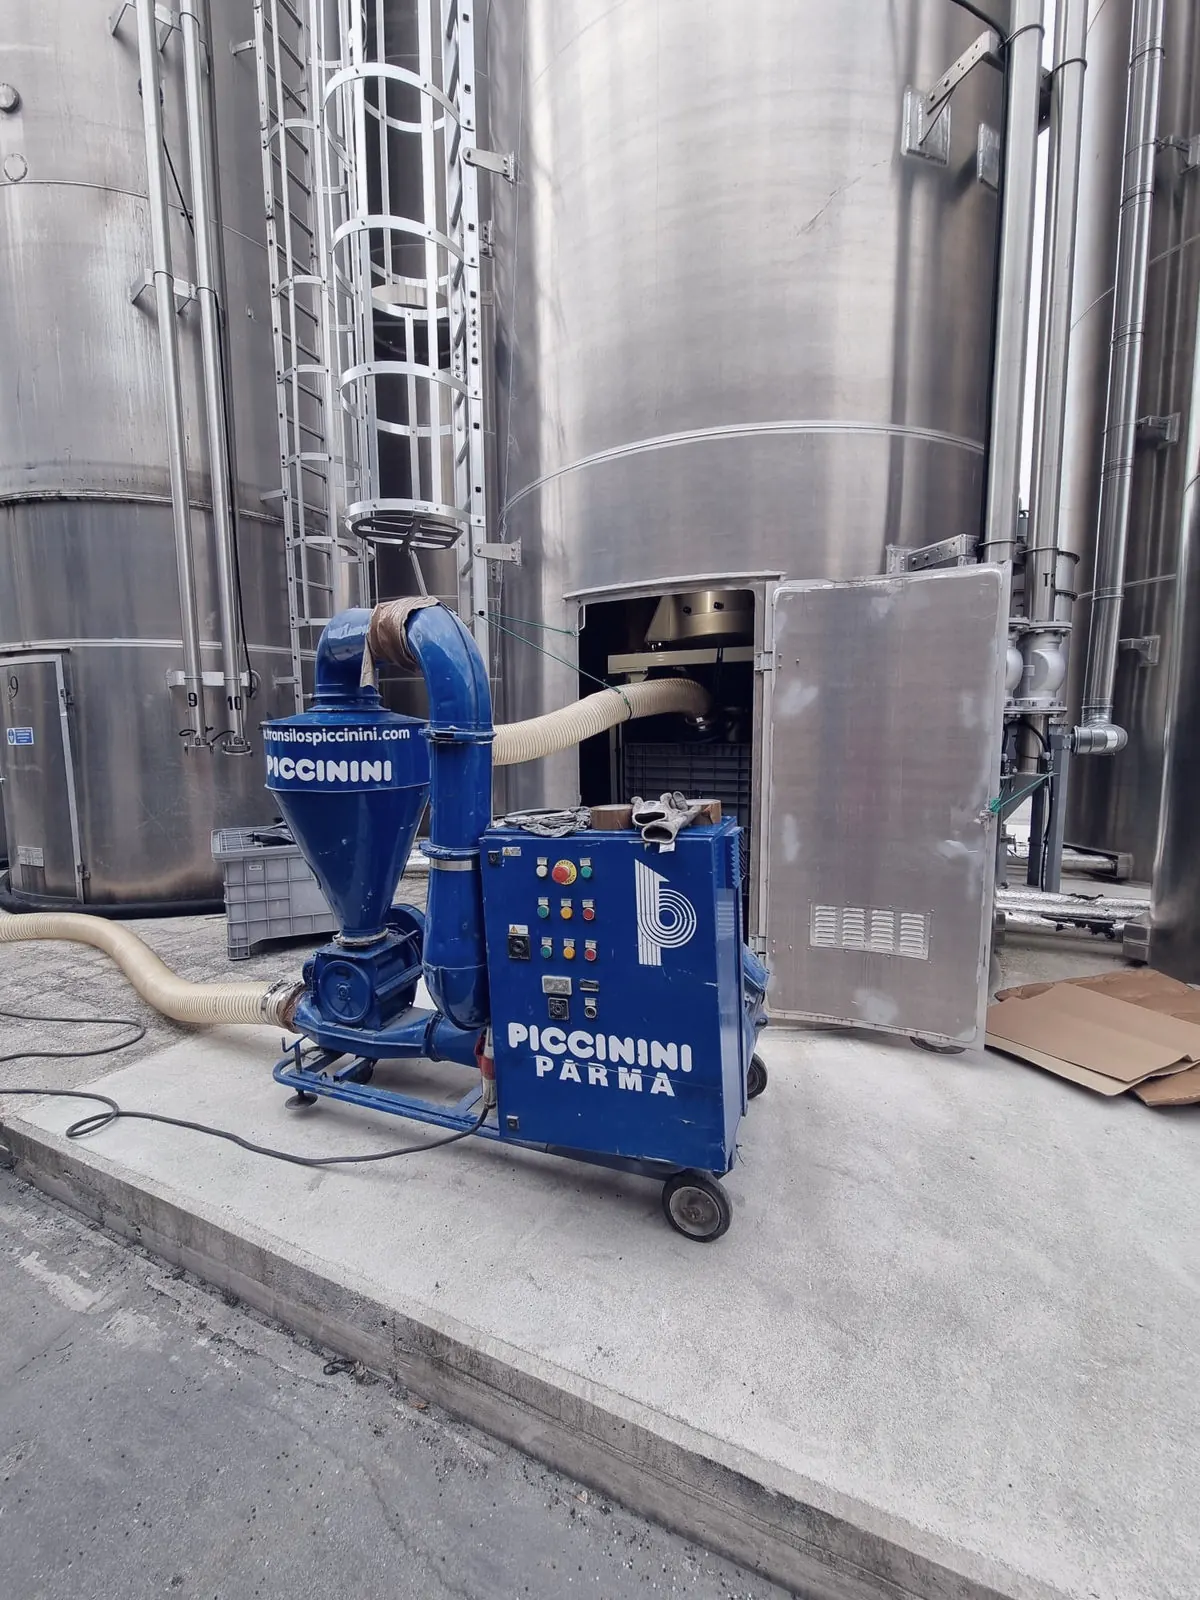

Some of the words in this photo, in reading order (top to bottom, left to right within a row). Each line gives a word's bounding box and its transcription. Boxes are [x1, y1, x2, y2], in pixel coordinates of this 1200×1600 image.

[10, 675, 19, 699] 9
[188, 692, 198, 707] 9
[227, 695, 242, 710] 10
[266, 754, 392, 782] PICCININI
[507, 1022, 692, 1072] PICCININI
[532, 1054, 675, 1097] PARMA
